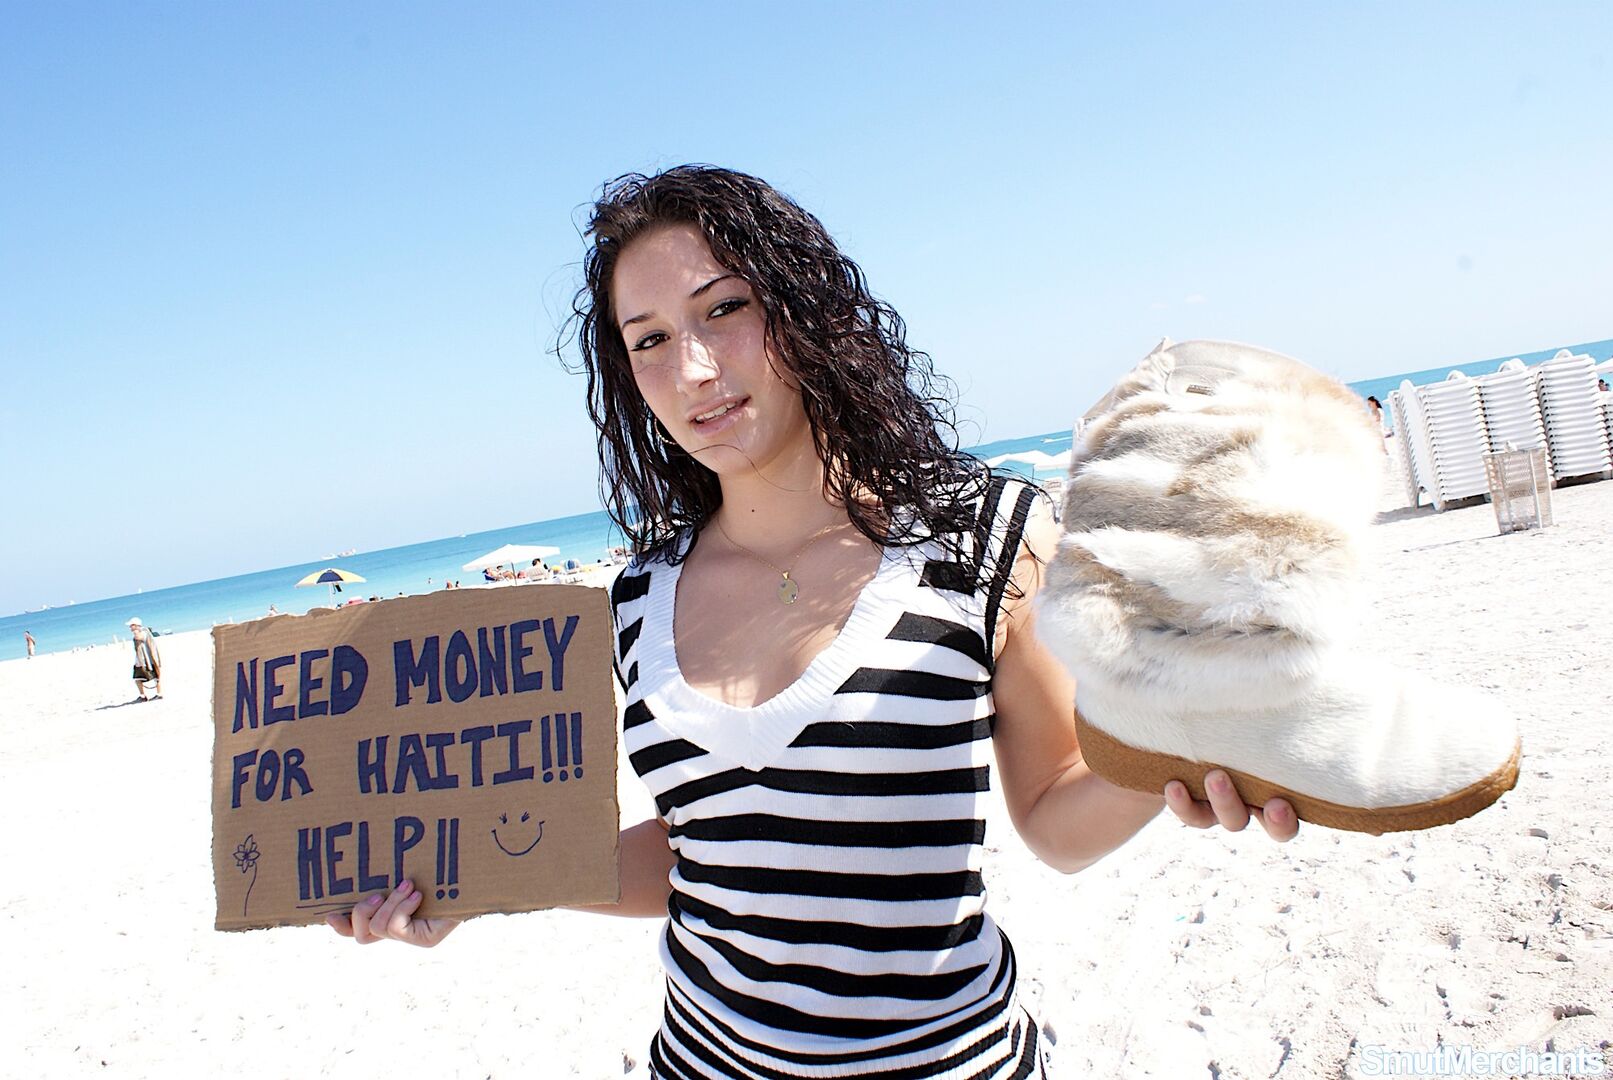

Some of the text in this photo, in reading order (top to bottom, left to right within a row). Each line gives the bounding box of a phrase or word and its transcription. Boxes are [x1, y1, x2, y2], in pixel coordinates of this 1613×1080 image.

[232, 615, 580, 733] NEED MONEY
[231, 711, 584, 809] FOR HAITI!!!
